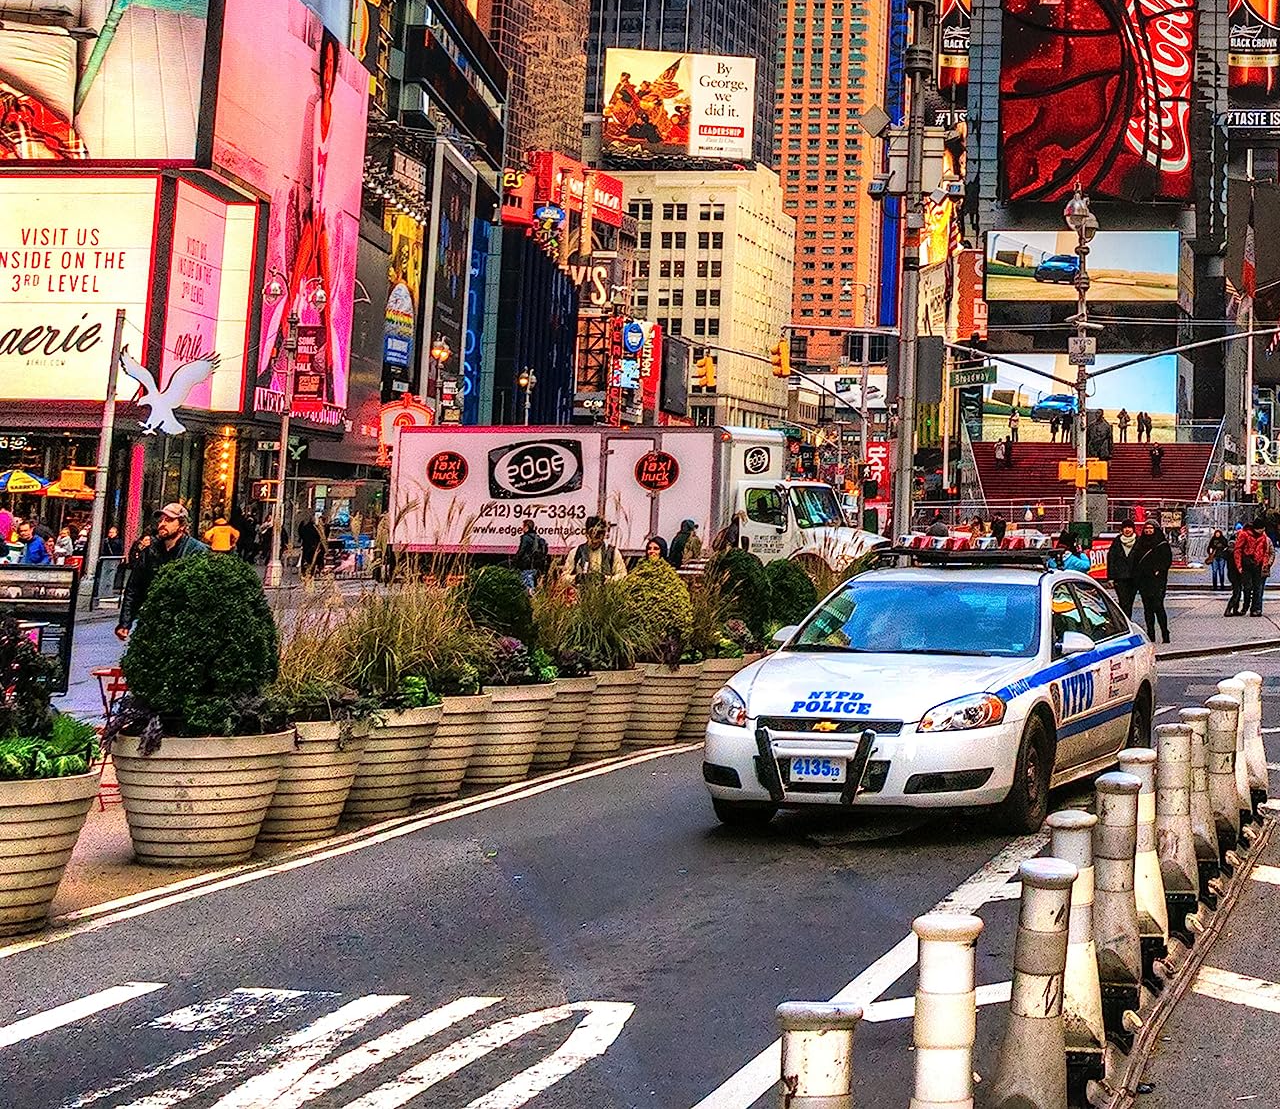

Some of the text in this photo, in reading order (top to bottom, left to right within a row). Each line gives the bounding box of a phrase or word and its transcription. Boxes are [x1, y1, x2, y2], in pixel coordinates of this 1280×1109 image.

[944, 40, 963, 49] BLACK
[1230, 39, 1277, 48] BLACK CROWN
[717, 62, 732, 77] By
[699, 75, 748, 91] George,
[714, 92, 732, 102] we
[704, 103, 739, 118] did it.
[1270, 112, 1280, 126] IS
[699, 126, 743, 136] LEADERSHIP
[21, 228, 100, 246] VISIT US
[61, 251, 84, 269] ON
[94, 251, 126, 269] THE
[48, 274, 100, 293] LEVEL
[0, 312, 103, 356] aerie
[298, 337, 316, 346] SOME
[954, 371, 989, 385] Broadway
[434, 459, 462, 470] taxi
[507, 454, 564, 483] edge
[643, 460, 671, 471] taxi
[868, 445, 887, 484] tkts
[431, 470, 458, 481] truck
[641, 471, 669, 482] truck
[480, 503, 586, 519] (212) 947-3343
[473, 525, 588, 537] www.edgetorental.co
[808, 691, 864, 701] NYPD
[1062, 671, 1095, 720] NYPD
[791, 701, 872, 715] POLICE
[793, 758, 831, 776] 4135
